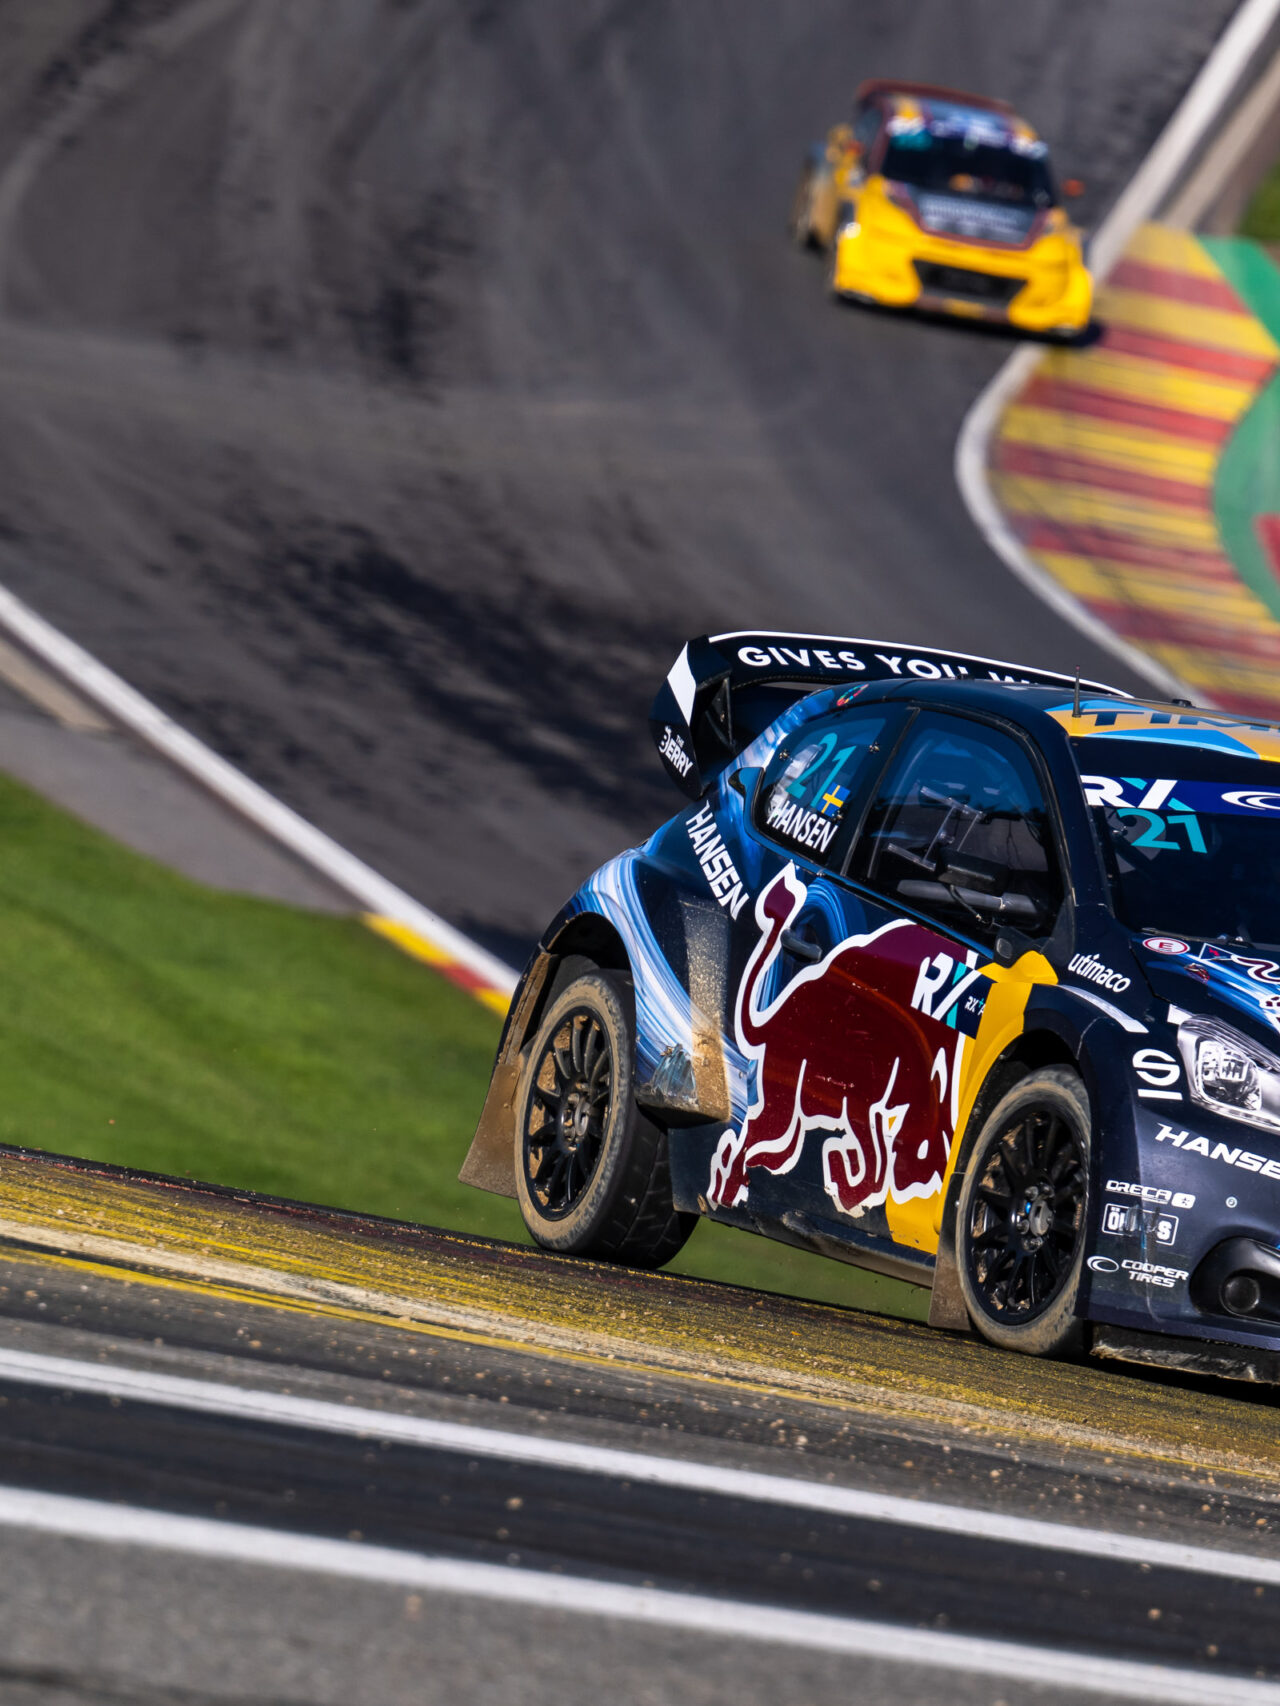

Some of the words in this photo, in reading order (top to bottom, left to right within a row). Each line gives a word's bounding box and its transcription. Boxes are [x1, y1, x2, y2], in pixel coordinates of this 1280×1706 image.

[737, 646, 866, 671] GIVES
[785, 732, 857, 808] 21
[766, 800, 839, 853] HANSEN
[1116, 808, 1208, 854] 21
[686, 800, 749, 920] HANSEN
[1067, 953, 1131, 993] utimaco
[1105, 1180, 1172, 1202] ORECA
[1121, 1259, 1189, 1280] COOPER
[1128, 1271, 1176, 1288] TIRES
